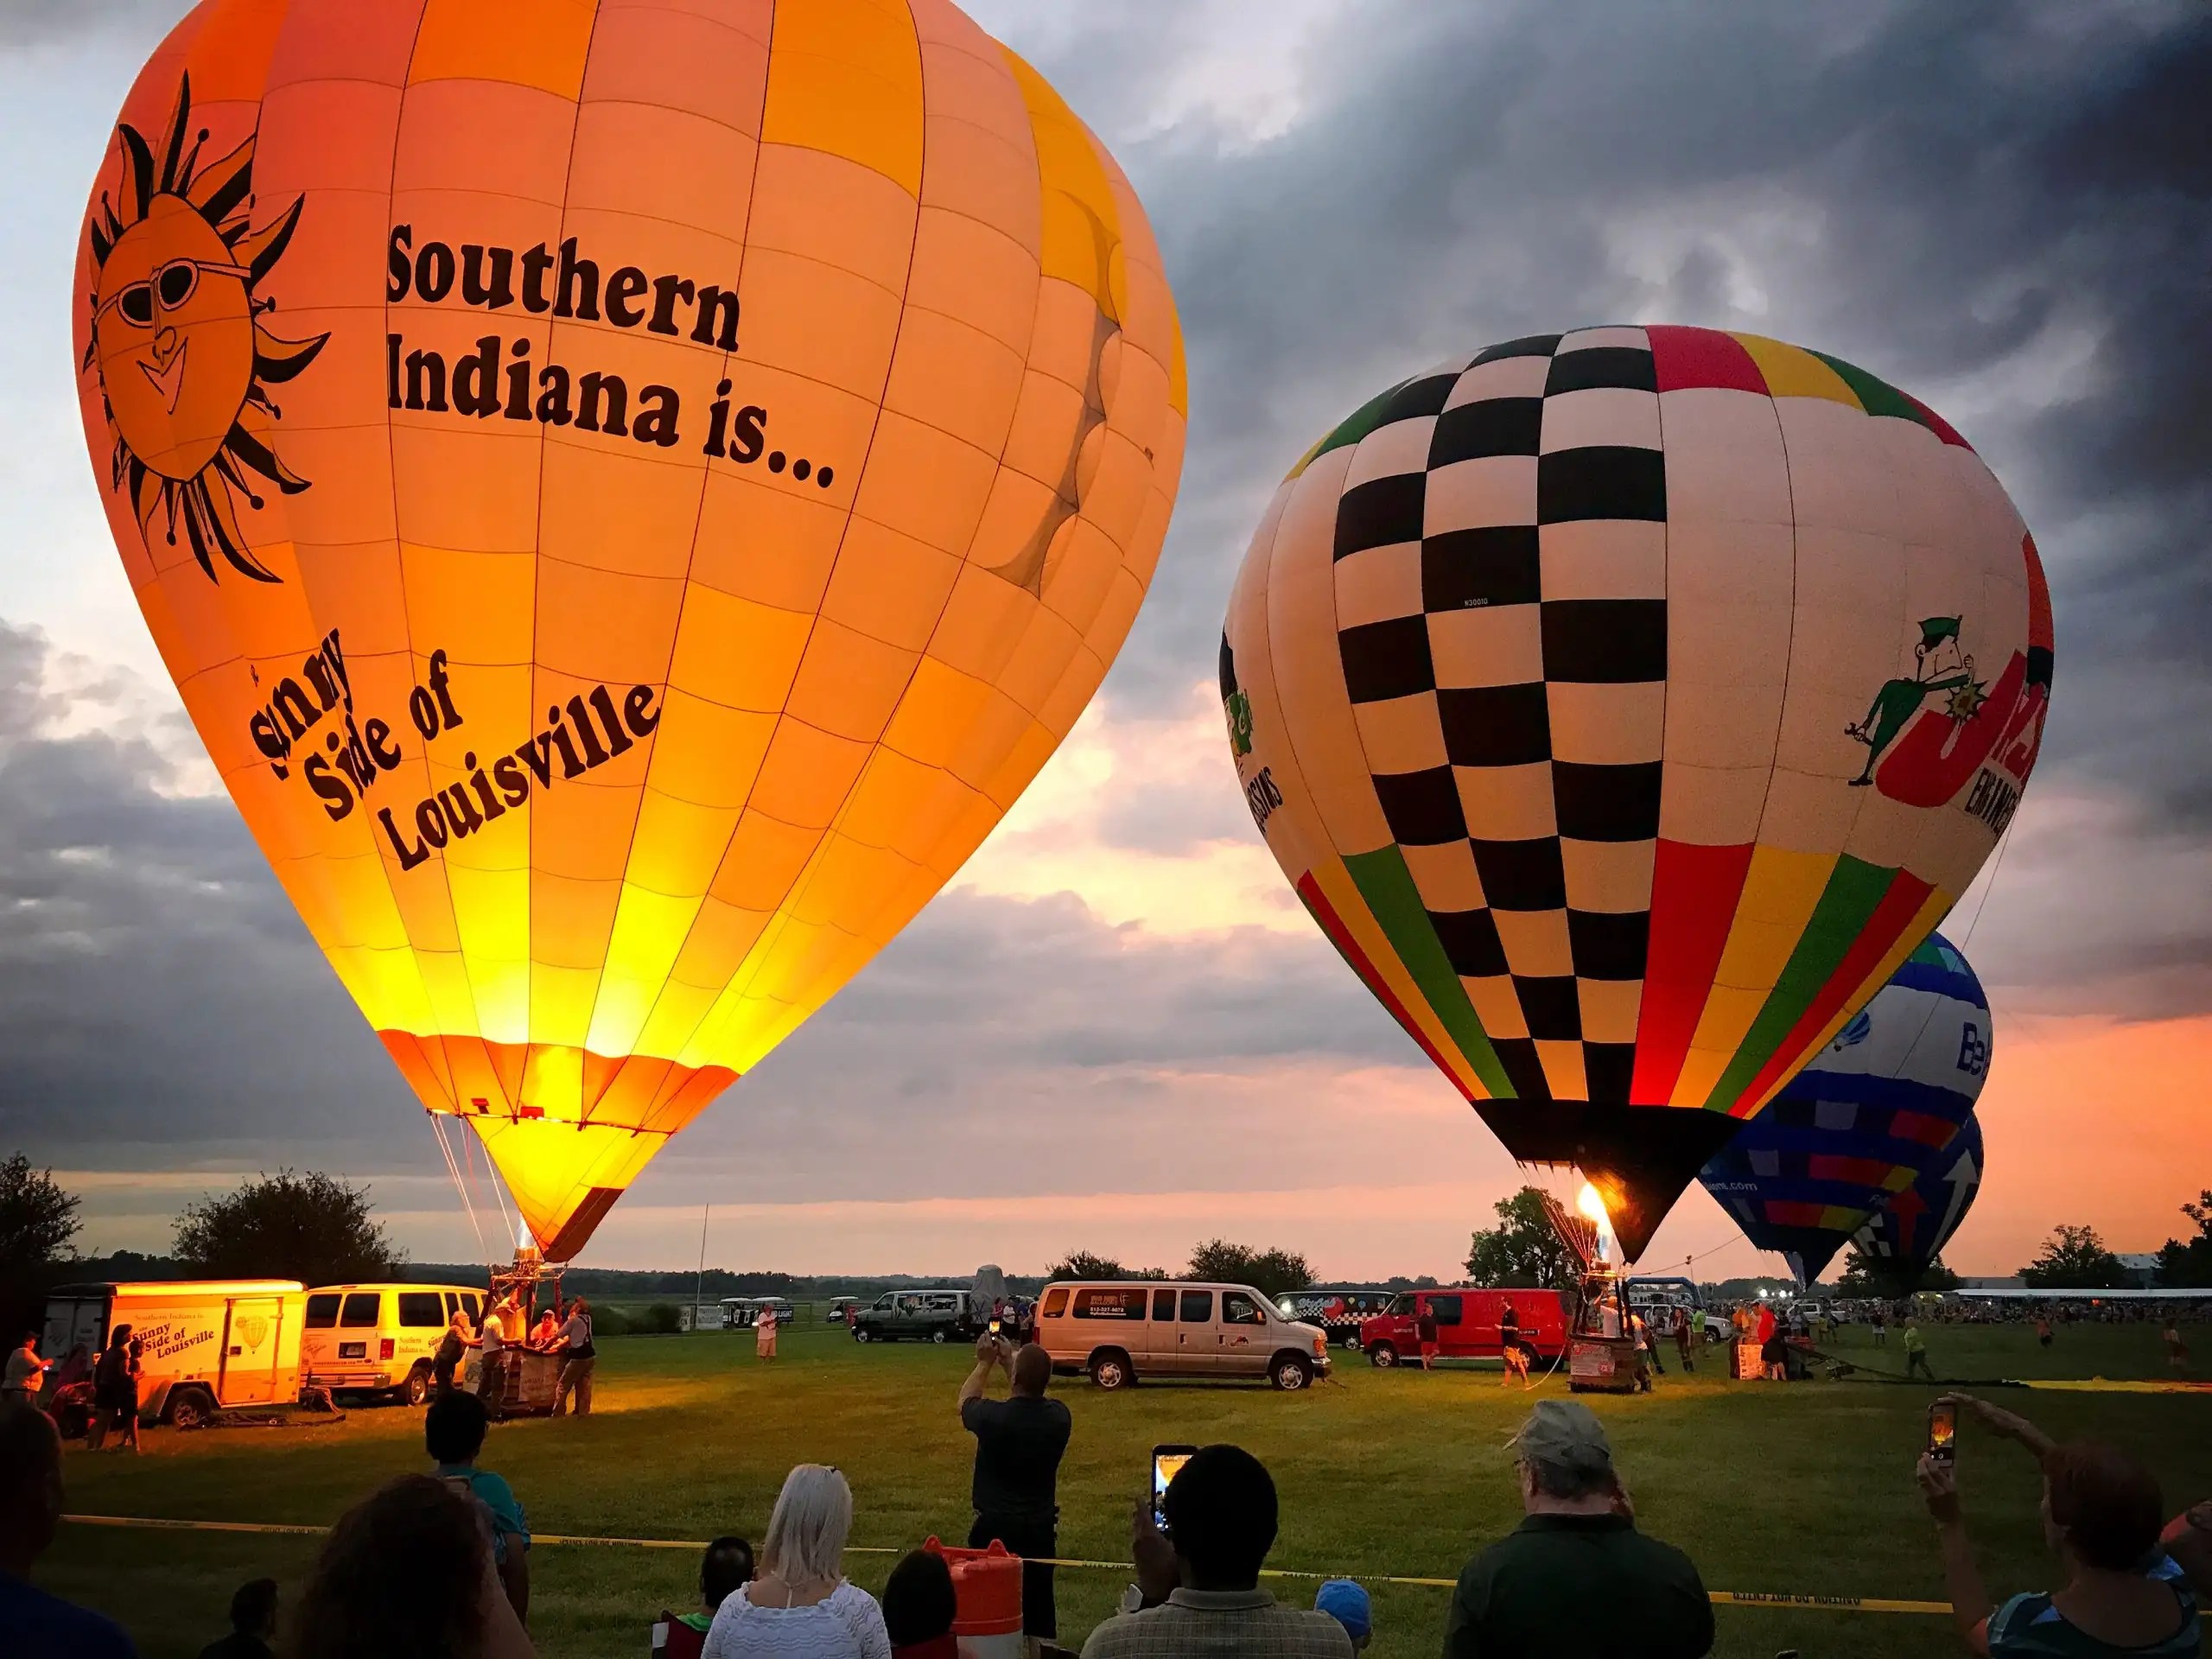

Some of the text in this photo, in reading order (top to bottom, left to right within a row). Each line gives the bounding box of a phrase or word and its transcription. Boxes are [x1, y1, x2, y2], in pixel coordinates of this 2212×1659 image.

[387, 223, 741, 353] Southern
[387, 333, 834, 488] Indiana is...
[303, 649, 463, 822] Side of
[378, 684, 661, 872] Louisville
[132, 1322, 171, 1341] Sunny
[145, 1326, 186, 1352] Side of
[156, 1330, 214, 1359] Louisville
[1770, 1593, 1791, 1603] NOT
[1796, 1595, 1809, 1604] DO
